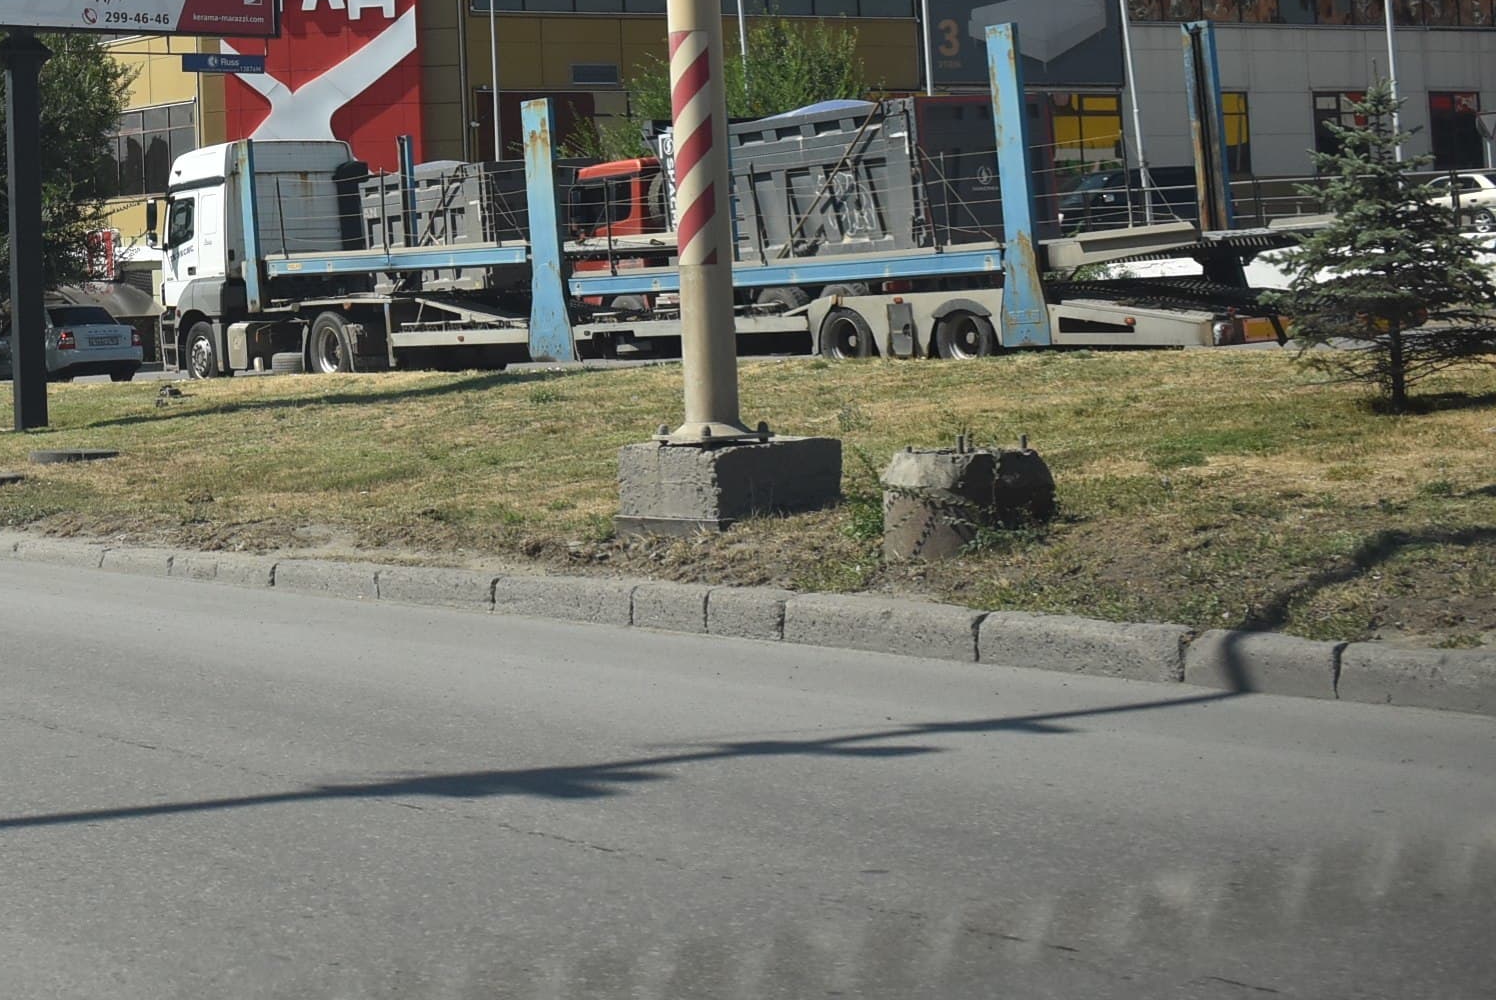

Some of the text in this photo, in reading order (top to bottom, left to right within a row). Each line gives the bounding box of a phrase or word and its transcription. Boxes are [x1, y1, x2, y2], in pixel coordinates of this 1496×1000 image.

[105, 11, 170, 25] 299-46-46
[192, 12, 265, 23] kerama-marazzi.com
[937, 18, 961, 57] 3
